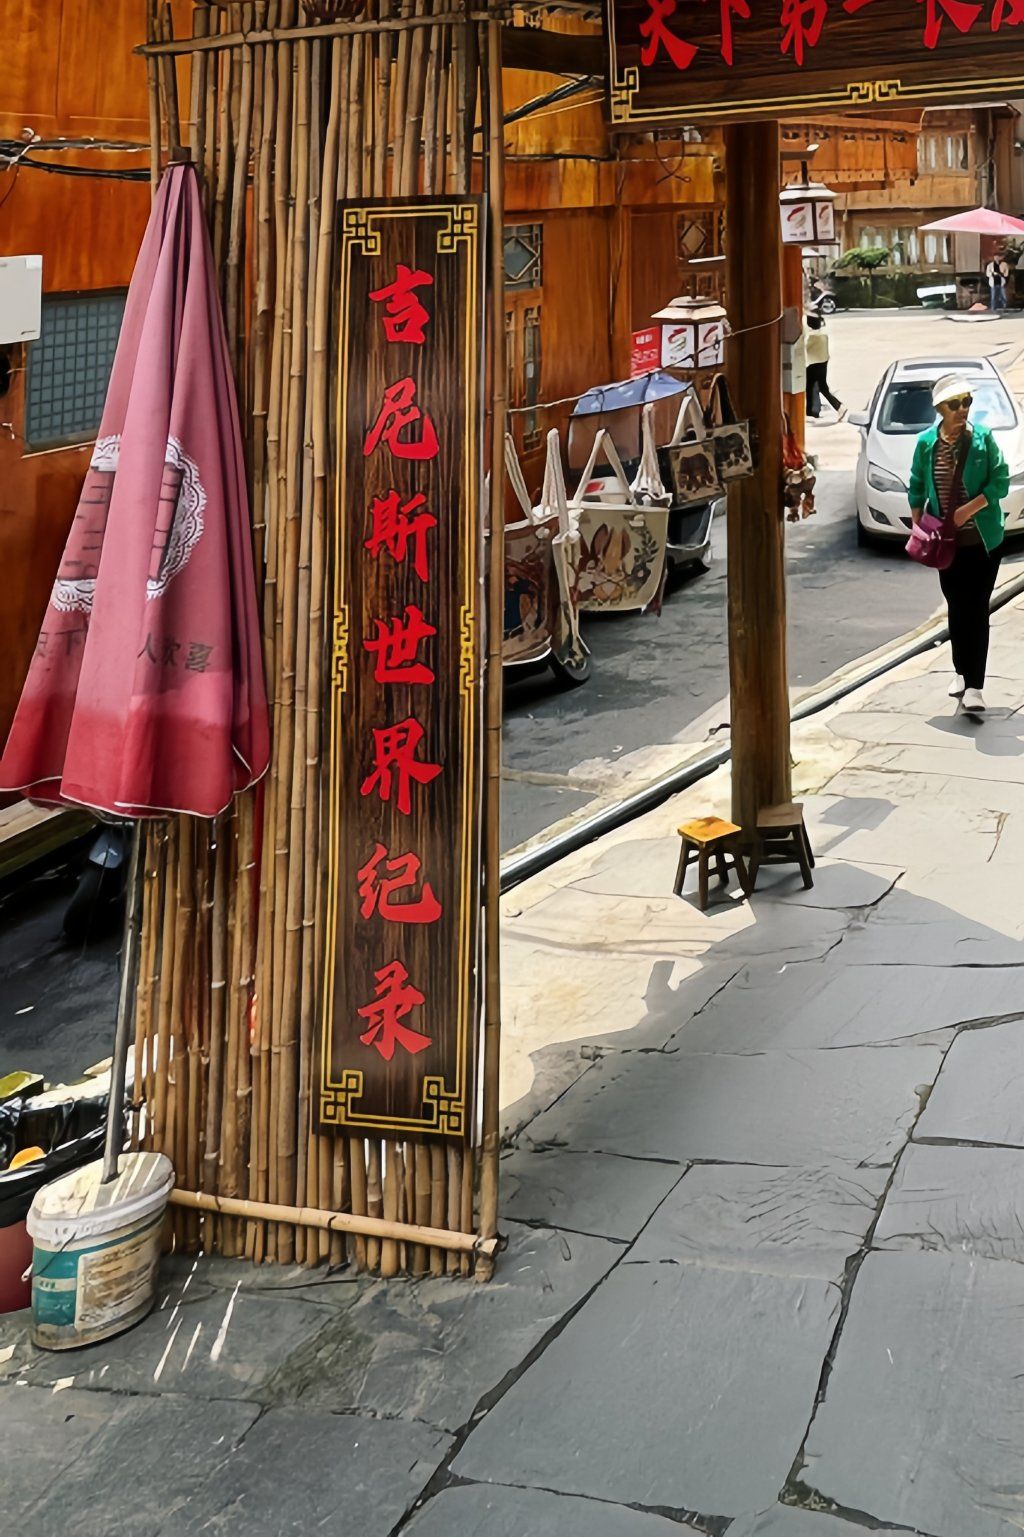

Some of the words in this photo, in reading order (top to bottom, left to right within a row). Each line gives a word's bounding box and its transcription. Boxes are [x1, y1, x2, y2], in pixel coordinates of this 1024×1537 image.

[357, 264, 443, 1061] 吉尼斯世界纪录
